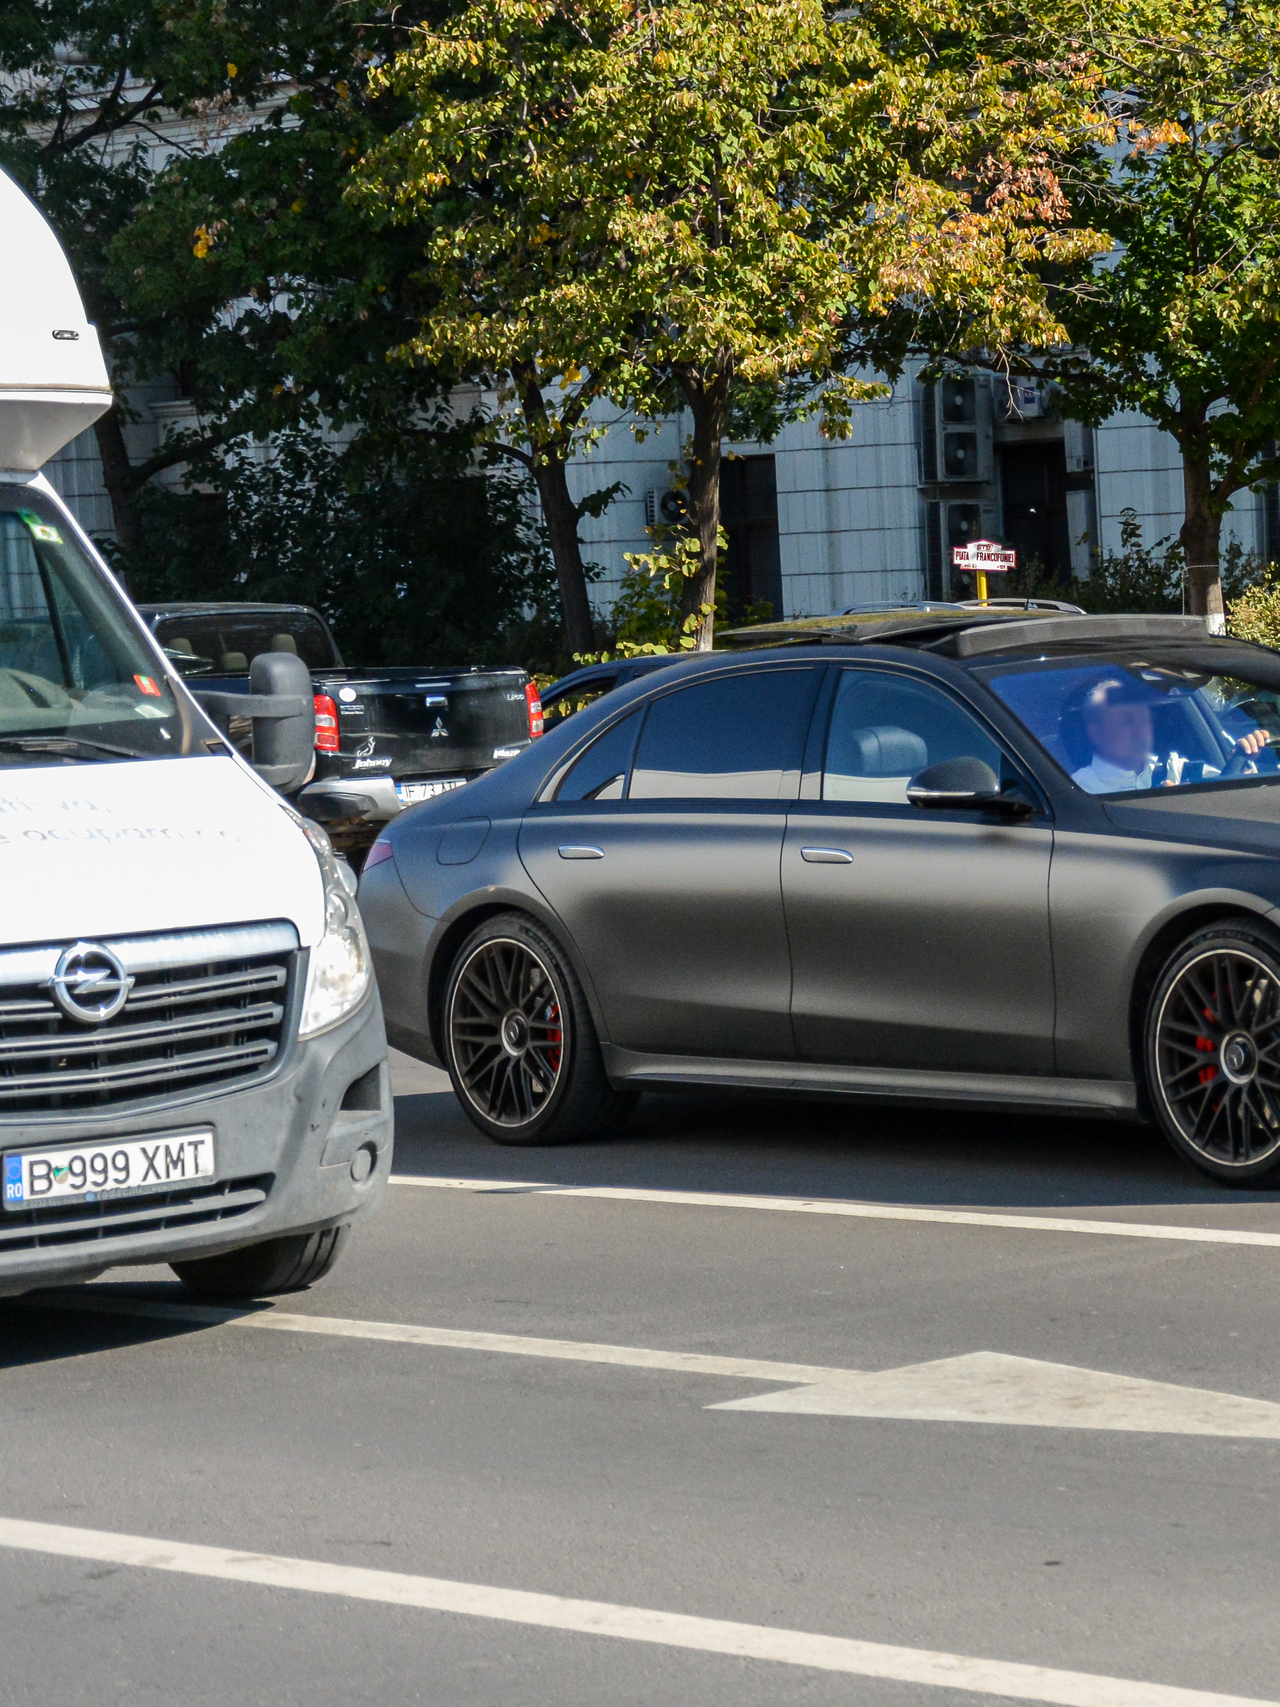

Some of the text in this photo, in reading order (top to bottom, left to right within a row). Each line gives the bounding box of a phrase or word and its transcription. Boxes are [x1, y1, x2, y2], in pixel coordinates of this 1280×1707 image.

[29, 1139, 205, 1196] B 999 XMT
[6, 1183, 23, 1198] RO
